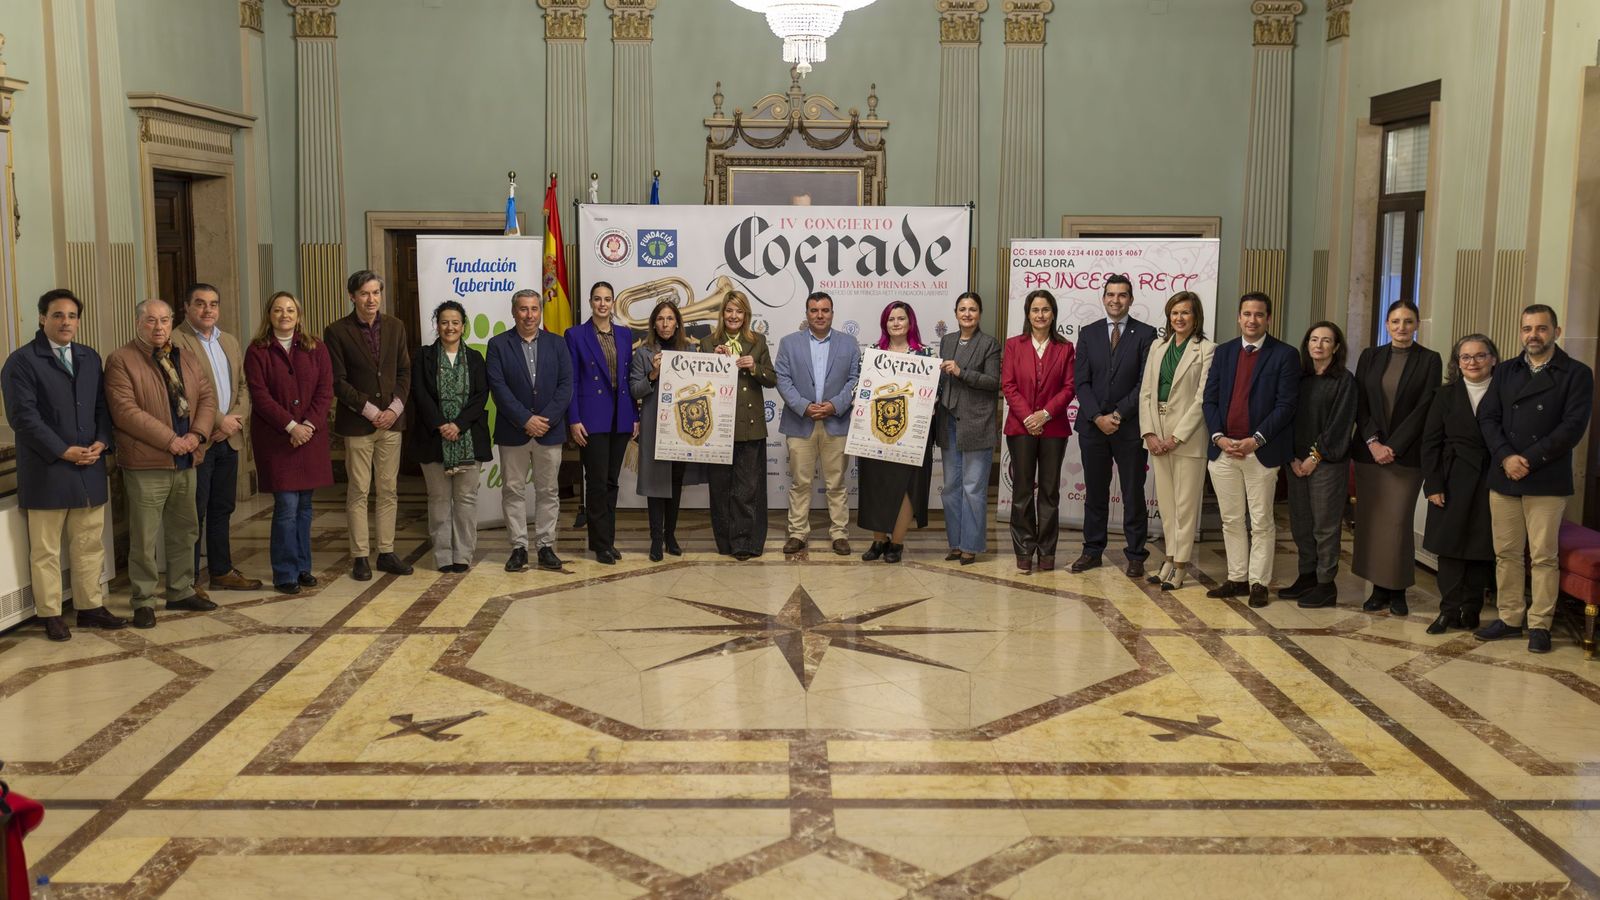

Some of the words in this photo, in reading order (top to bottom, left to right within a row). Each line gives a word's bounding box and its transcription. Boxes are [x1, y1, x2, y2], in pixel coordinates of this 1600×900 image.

[779, 217, 798, 230] IV
[804, 217, 893, 231] CONCIERTO
[640, 230, 675, 248] FUNDACIÓN
[641, 251, 674, 266] LABERINTO
[722, 212, 952, 297] Cofrade
[1012, 248, 1028, 256] CC:
[1086, 249, 1104, 257] 4102
[446, 256, 517, 274] Fundación
[1012, 258, 1075, 268] COLABORA
[452, 277, 515, 297] Laberinto
[819, 280, 874, 289] SOLIDARIO
[877, 280, 926, 289] PRINCESA
[930, 281, 949, 289] ARI
[671, 354, 731, 377] Cofrade
[874, 353, 934, 376] Cofrade
